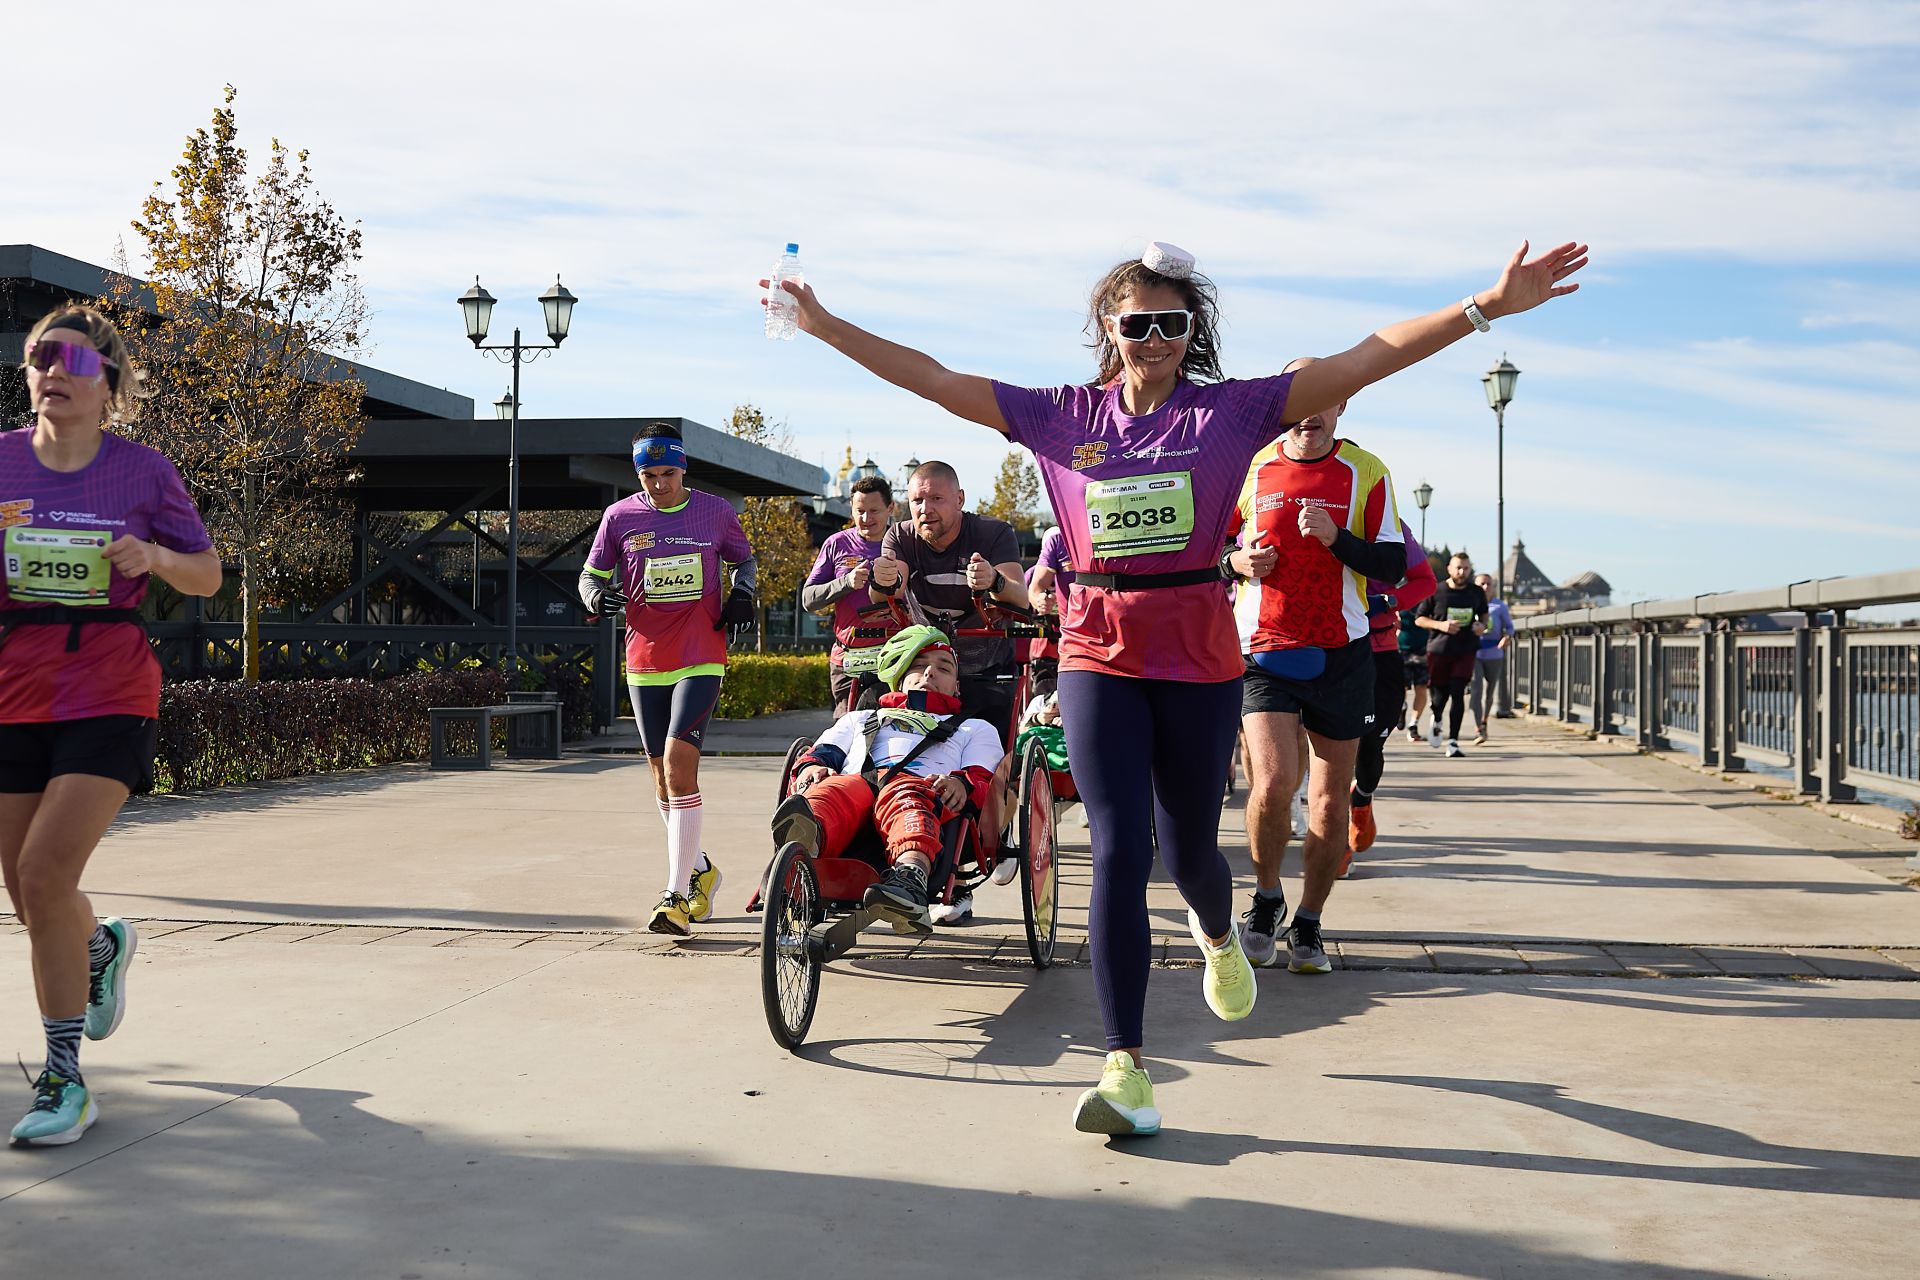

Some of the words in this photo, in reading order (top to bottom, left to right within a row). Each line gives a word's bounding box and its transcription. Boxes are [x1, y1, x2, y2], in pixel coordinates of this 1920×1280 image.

[1082, 451, 1095, 459] ЕМ
[1073, 457, 1104, 469] МОЖЕШЬ
[1106, 506, 1177, 530] 2038
[27, 561, 89, 580] 2199
[654, 574, 695, 588] 2442
